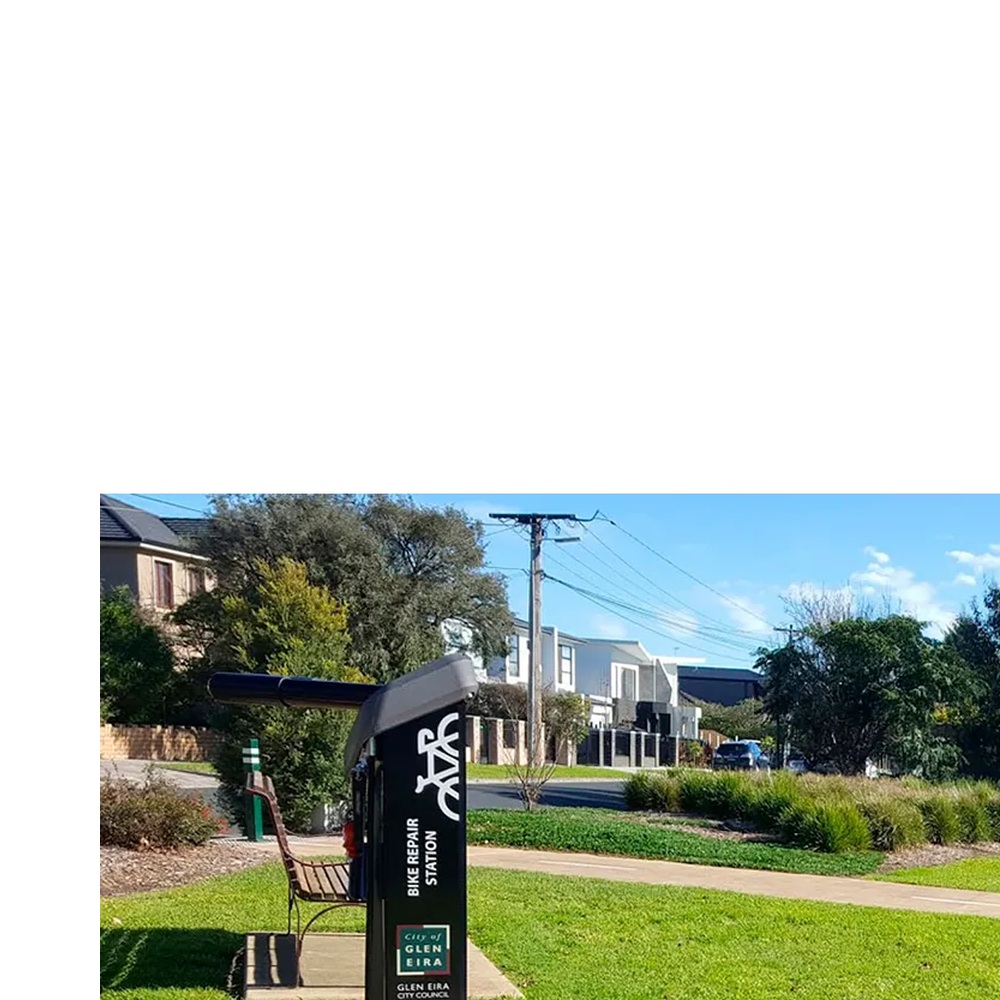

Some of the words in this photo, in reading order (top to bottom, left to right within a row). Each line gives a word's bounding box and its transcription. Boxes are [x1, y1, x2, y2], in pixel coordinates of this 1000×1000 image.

[406, 818, 419, 865] REPAIR
[424, 830, 438, 886] STATION
[407, 867, 420, 897] BIKE
[404, 932, 427, 942] City
[430, 932, 442, 942] of
[404, 944, 442, 954] GLEN
[406, 958, 442, 968] EIRA
[396, 983, 424, 992] GLEN
[427, 982, 450, 991] EIRA
[396, 992, 415, 1000] CITY
[415, 991, 450, 999] COUNCIL
